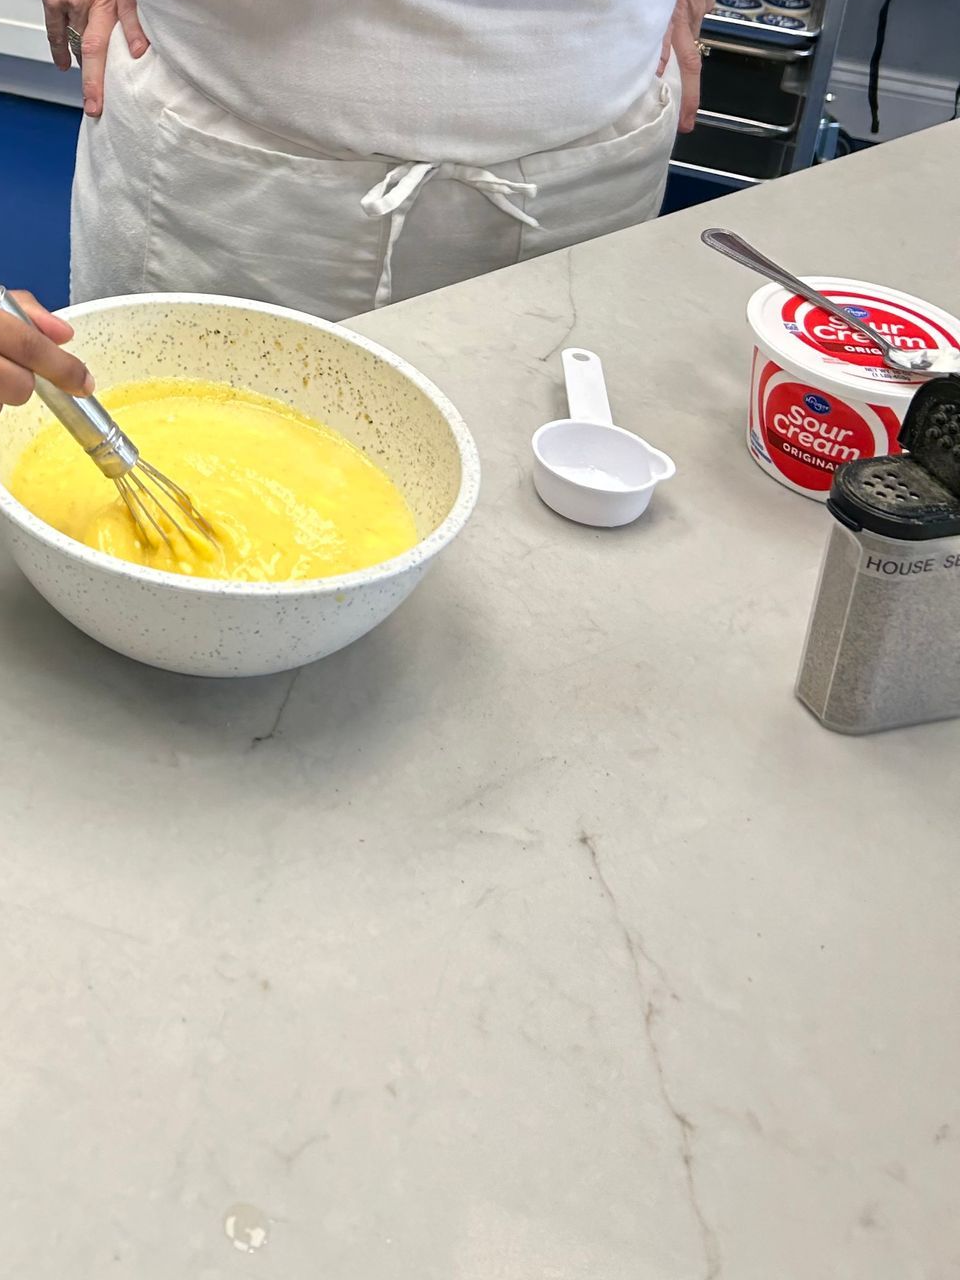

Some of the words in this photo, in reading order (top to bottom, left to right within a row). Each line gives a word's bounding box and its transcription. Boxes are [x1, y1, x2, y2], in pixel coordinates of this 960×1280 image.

[828, 314, 905, 336] Sur
[805, 396, 830, 411] Kroger
[787, 405, 854, 442] Sour
[773, 413, 861, 462] Cream
[866, 555, 936, 576] HOUSE
